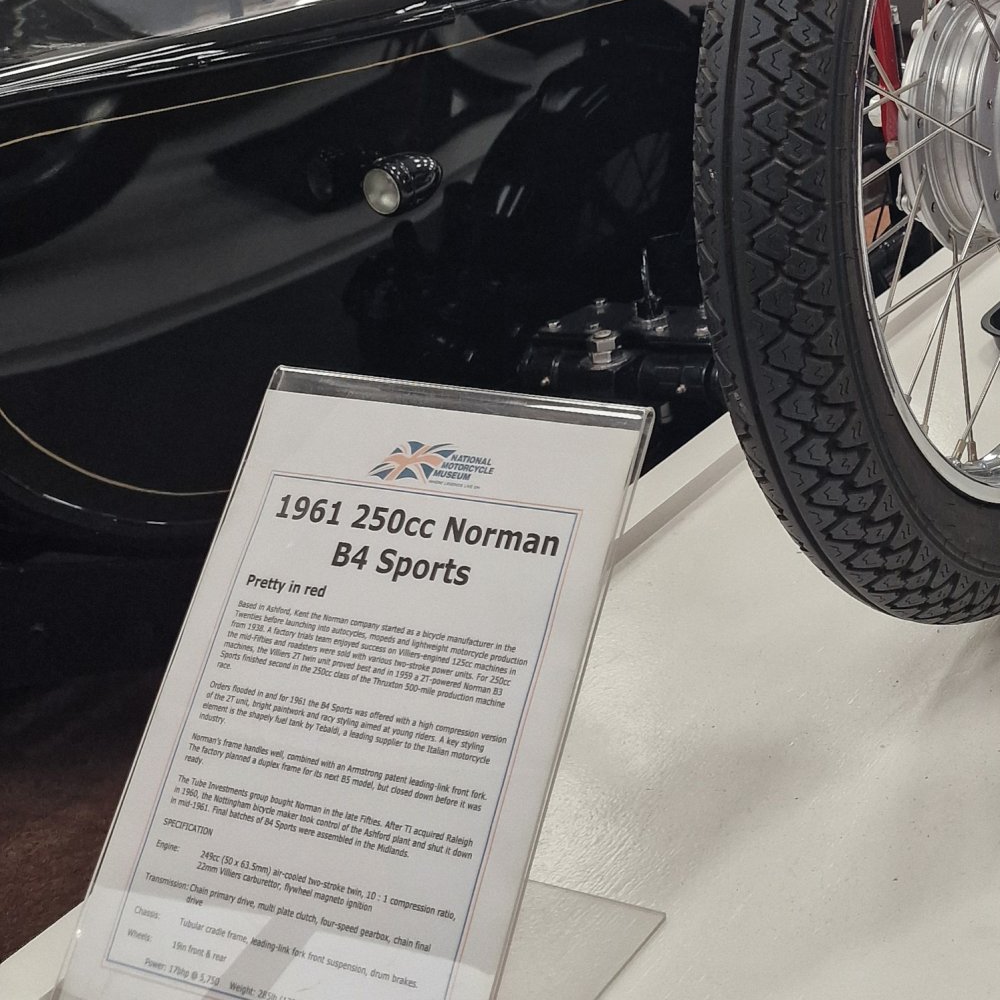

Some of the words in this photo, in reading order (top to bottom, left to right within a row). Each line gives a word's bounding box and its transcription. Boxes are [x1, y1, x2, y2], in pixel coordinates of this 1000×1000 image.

[433, 469, 472, 481] MUSEUM
[441, 461, 495, 475] MOTORCYCLE
[451, 454, 492, 466] NATIONAL
[275, 494, 343, 526] 1961
[350, 503, 437, 539] 250cc
[442, 515, 560, 557] Norman
[245, 573, 287, 595] Pretty
[287, 579, 302, 594] in
[303, 584, 328, 598] red
[330, 541, 370, 571] B4
[375, 547, 472, 586] Sports
[230, 619, 247, 630] from
[272, 626, 297, 639] factory
[296, 630, 315, 641] trials
[314, 633, 333, 645] team
[332, 638, 361, 649] enjoyed
[359, 642, 387, 654] success
[387, 647, 398, 655] on
[450, 657, 474, 669] 125cc
[472, 662, 509, 675] machines
[508, 666, 517, 676] in
[234, 609, 264, 622] Twenties
[262, 614, 287, 626] before
[284, 617, 317, 632] launching
[316, 623, 331, 633] into
[368, 633, 397, 644] mopeds
[395, 637, 412, 647] and
[410, 638, 450, 654] lightweight
[449, 647, 490, 660] motorcycle
[488, 653, 529, 667] production
[237, 599, 259, 610] Based
[257, 602, 266, 612] in
[293, 608, 311, 619] Kent
[309, 611, 323, 621] the
[322, 613, 350, 625] Norman
[348, 619, 381, 632] company
[380, 623, 407, 635] started
[405, 628, 416, 637] as
[421, 629, 447, 642] bicycle
[445, 635, 495, 650] manufacturer
[493, 641, 503, 651] in
[503, 643, 517, 654] the
[219, 649, 242, 661] Sports
[241, 653, 269, 666] finished
[267, 659, 293, 670] second
[291, 661, 300, 671] in
[299, 663, 313, 674] the
[311, 665, 334, 678] 250cc
[332, 669, 351, 681] class
[350, 673, 361, 682] of
[359, 674, 372, 685] the
[372, 676, 404, 690] Thruxton
[435, 689, 475, 703] production
[474, 696, 506, 709] machine
[226, 630, 239, 639] the
[273, 638, 288, 647] and
[286, 641, 319, 653] roadsters
[318, 646, 337, 656] were
[335, 649, 352, 659] sold
[351, 651, 368, 661] with
[367, 655, 394, 666] various
[430, 666, 455, 677] power
[475, 672, 490, 684] For
[488, 674, 512, 687] 250cc
[256, 645, 269, 655] the
[269, 647, 292, 659] Villiers
[290, 651, 303, 661] 2T
[301, 653, 317, 664] twin
[316, 657, 332, 666] unit
[330, 659, 357, 671] proved
[355, 662, 372, 674] best
[370, 666, 387, 676] and
[385, 668, 395, 677] in
[393, 668, 414, 681] 1959
[462, 681, 492, 695] Norman
[491, 686, 504, 697] B3
[221, 738, 243, 751] frame
[242, 742, 270, 756] handles
[286, 753, 321, 767] combined
[320, 759, 336, 770] with
[335, 763, 347, 772] an
[345, 764, 384, 781] Armstrong
[383, 773, 408, 785] patent
[450, 785, 471, 798] front
[162, 817, 214, 837] SPECIFICATION
[169, 795, 178, 805] in
[211, 804, 229, 817] Final
[228, 808, 256, 824] batches
[255, 815, 265, 825] of
[263, 816, 275, 827] B4
[273, 819, 298, 833] Sports
[297, 826, 316, 837] were
[315, 830, 355, 846] assembled
[353, 837, 363, 848] in
[362, 839, 376, 851] the
[185, 894, 204, 907] drive
[195, 860, 219, 874] 22mm
[219, 866, 243, 880] Villiers
[283, 882, 314, 898] flywheel
[313, 891, 345, 906] magneto
[345, 897, 373, 913] ignition
[199, 849, 221, 863] 249cc
[364, 890, 377, 901] 10
[389, 897, 436, 916] compression
[188, 883, 209, 896] Chain
[208, 889, 237, 905] primary
[274, 905, 295, 919] plate
[392, 935, 414, 949] chain
[413, 940, 432, 953] final
